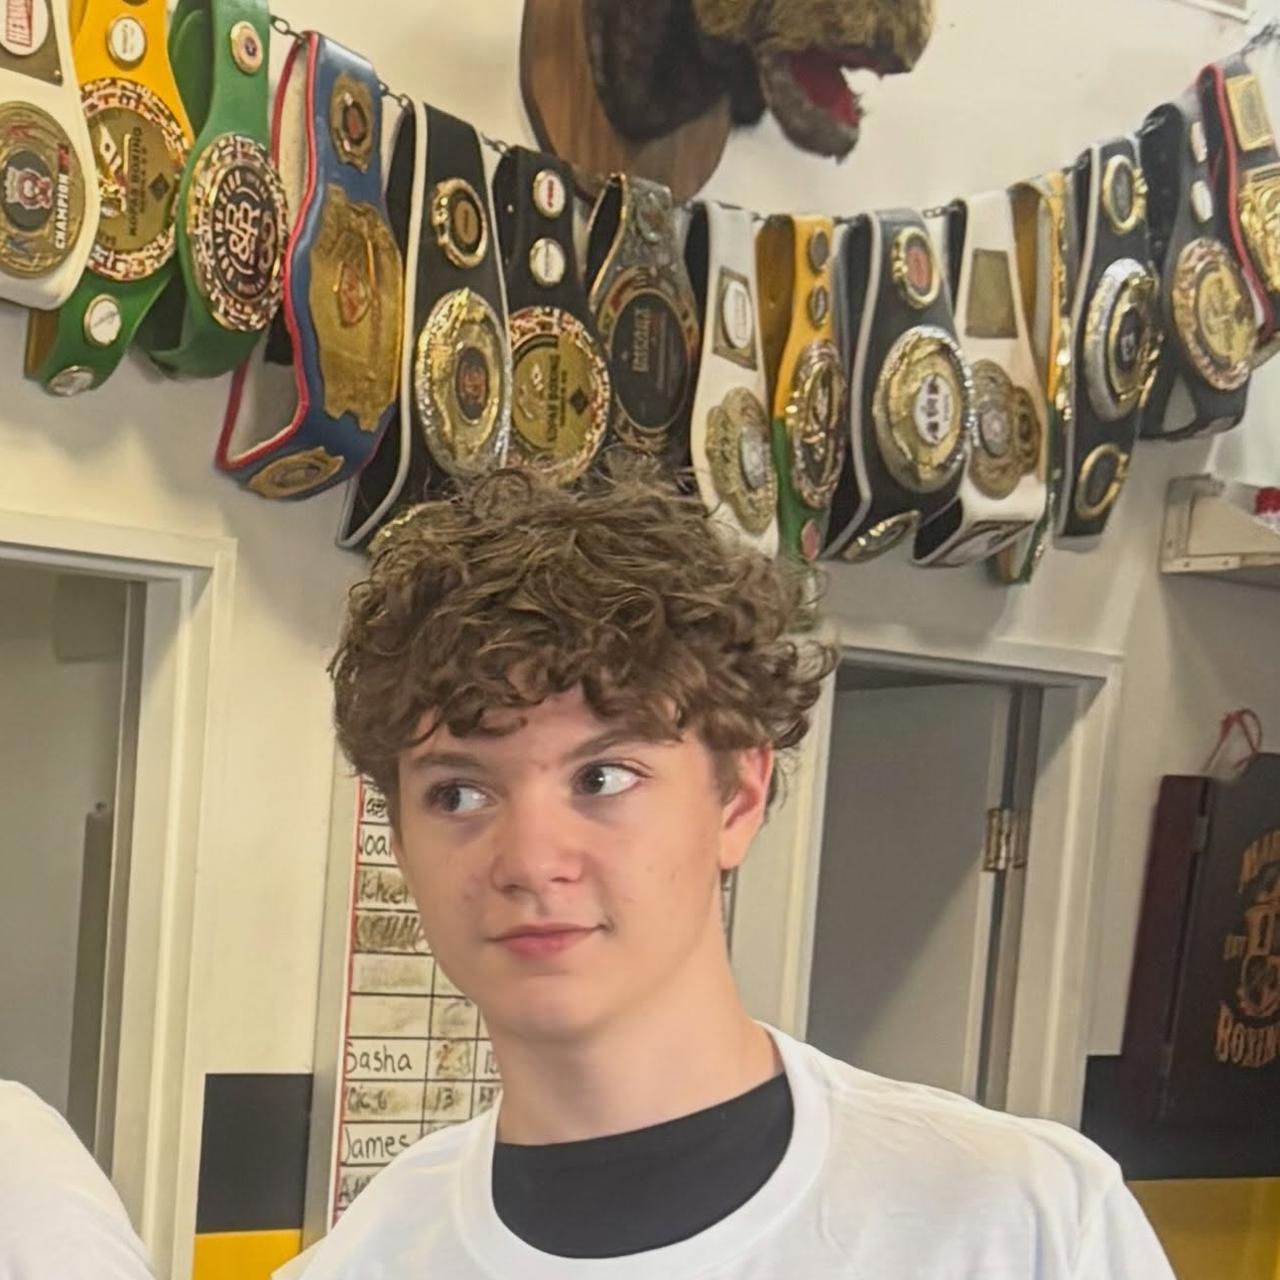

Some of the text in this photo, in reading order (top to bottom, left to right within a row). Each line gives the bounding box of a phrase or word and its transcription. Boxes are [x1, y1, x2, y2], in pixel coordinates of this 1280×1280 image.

[54, 172, 69, 250] CHAMPION
[345, 1042, 413, 1074] Sasha
[344, 1126, 411, 1165] James
